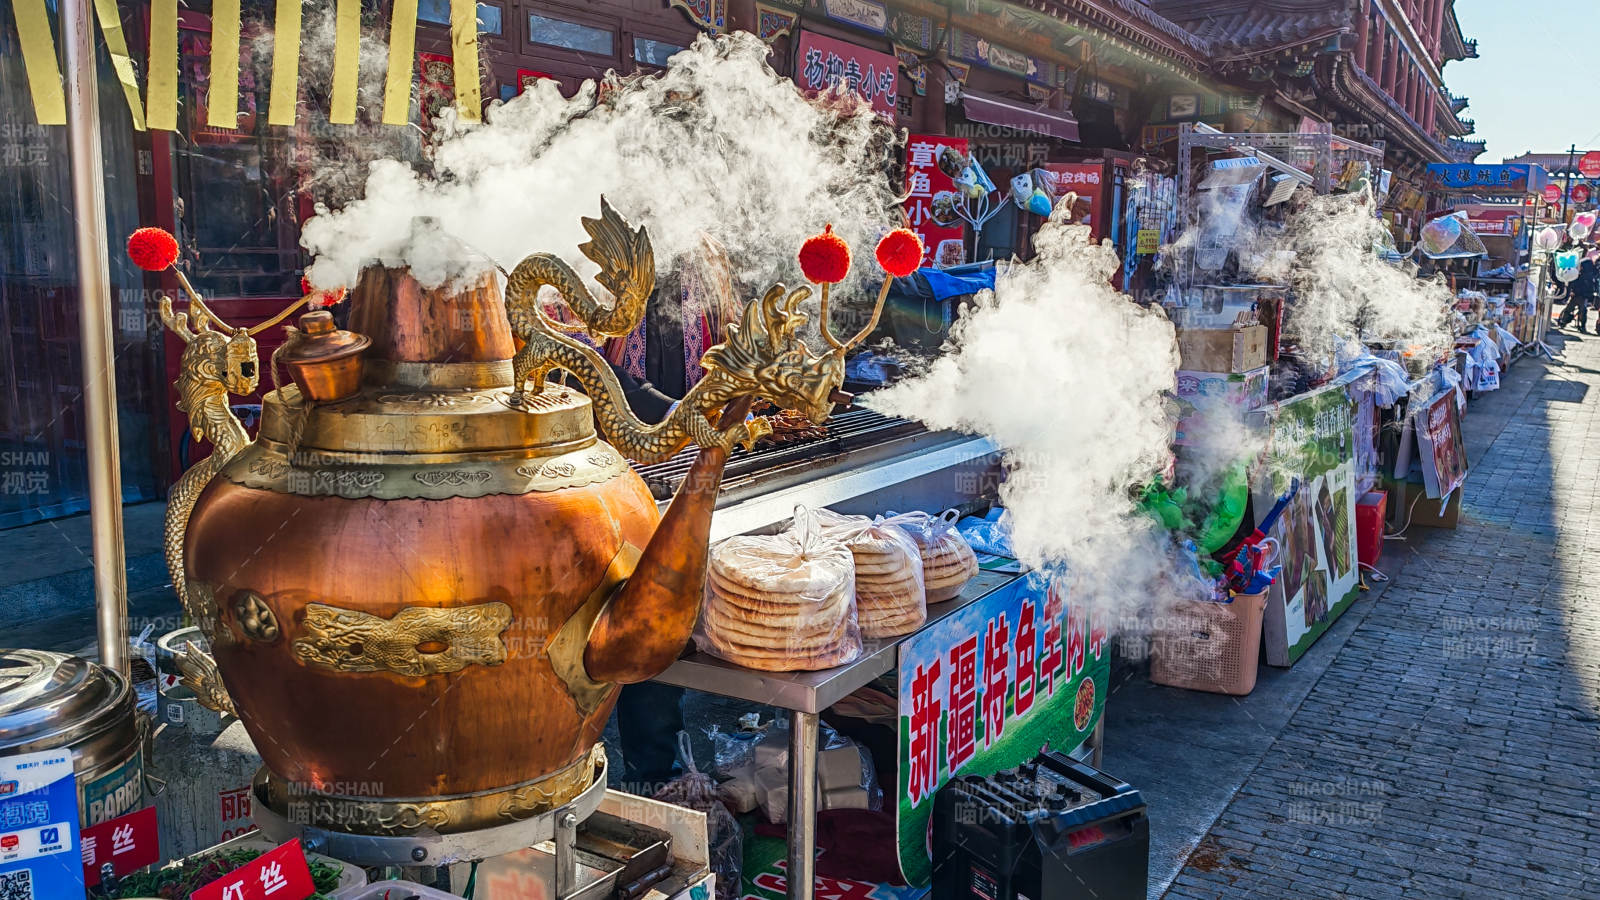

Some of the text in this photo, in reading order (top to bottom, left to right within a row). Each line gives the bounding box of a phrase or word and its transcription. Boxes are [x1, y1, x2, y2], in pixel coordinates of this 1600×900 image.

[804, 46, 897, 106] 杨柳青小吃
[1437, 168, 1513, 185] 火爆鱿鱼
[907, 577, 1110, 809] 新疆特色羊肉串
[81, 823, 136, 866] 青丝
[222, 860, 288, 900] 红丝
